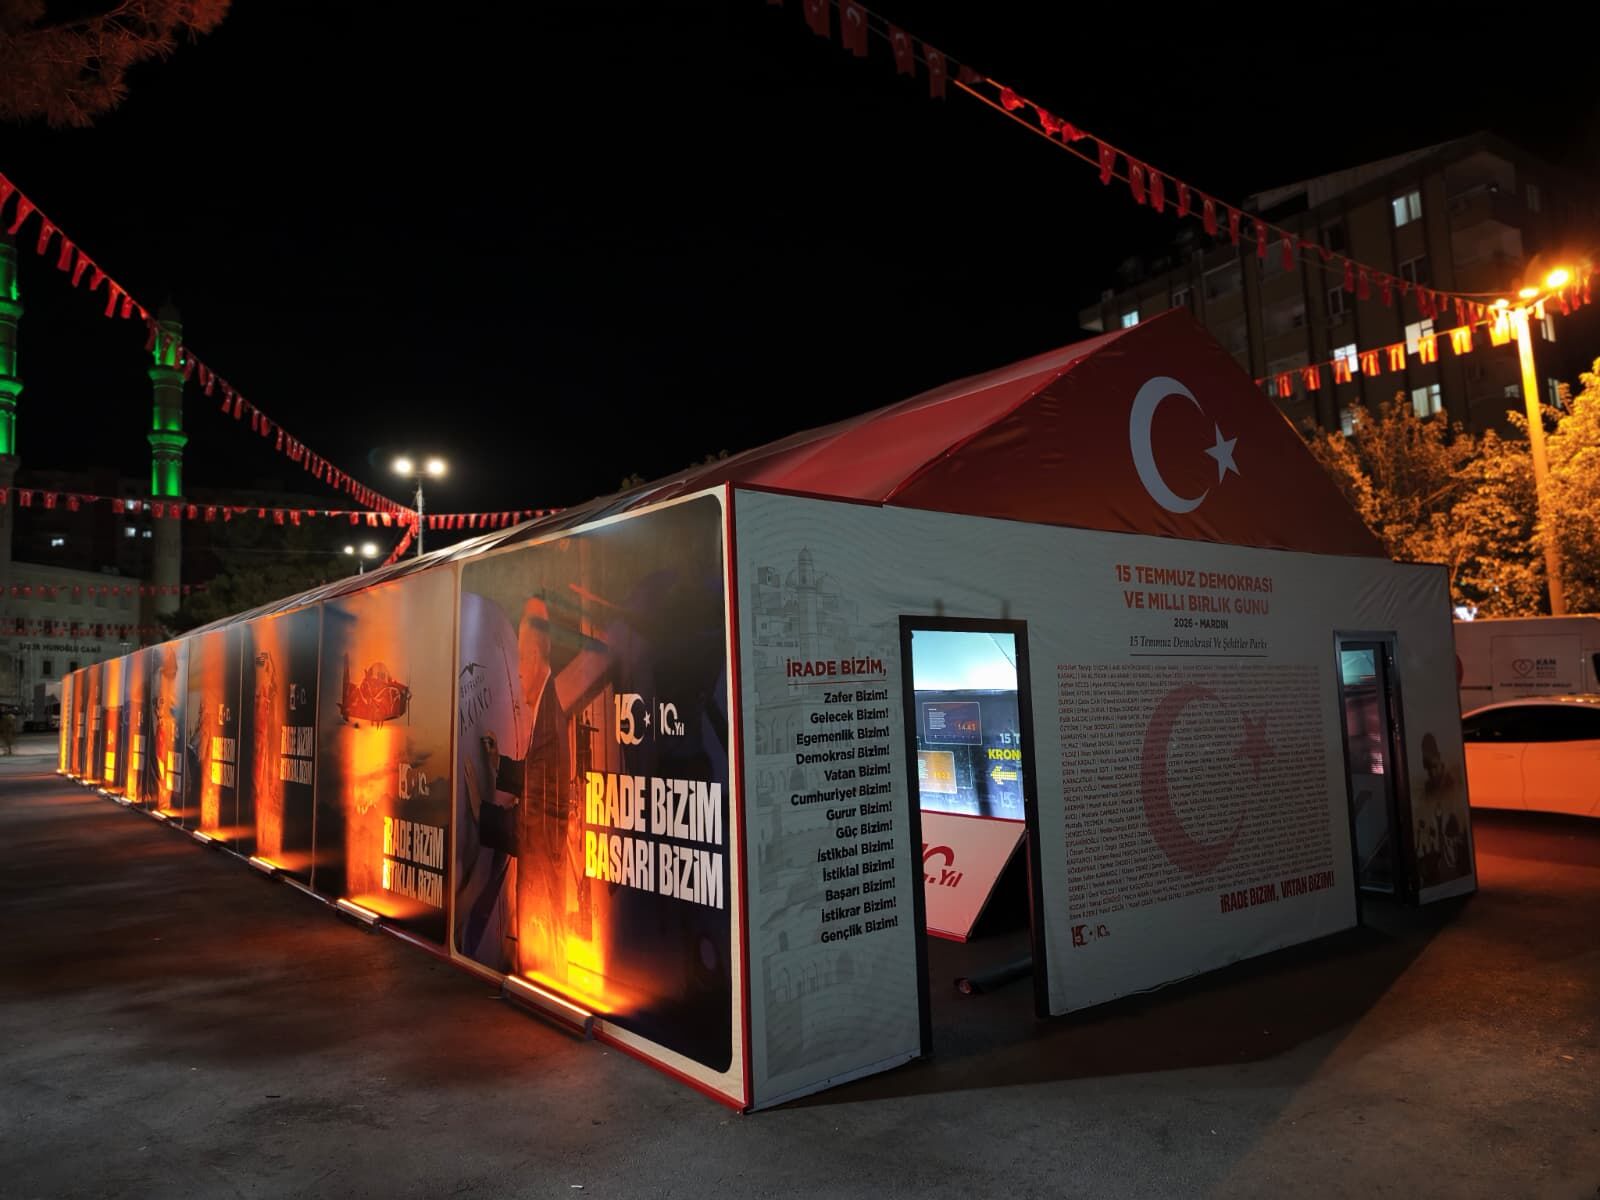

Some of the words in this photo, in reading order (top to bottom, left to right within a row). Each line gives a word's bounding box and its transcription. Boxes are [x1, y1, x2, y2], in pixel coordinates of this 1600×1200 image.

[1115, 564, 1132, 583] 15
[1135, 565, 1196, 588] TEMMUZ
[1199, 571, 1273, 593] DEMOKRASİ
[1124, 591, 1145, 609] VE
[1174, 617, 1193, 628] 2026
[1130, 635, 1138, 647] 15
[1140, 635, 1171, 648] Temmuz
[1173, 637, 1212, 649] Demokrasi
[787, 658, 837, 677] İRADE
[841, 656, 887, 677] BİZİM,
[824, 692, 853, 704] Zafer
[856, 689, 888, 702] Bizim!
[810, 710, 853, 724] Gelecek
[857, 708, 889, 720] Bizim!
[796, 729, 854, 746] Egemenlik
[857, 726, 890, 739] Bizim!
[1000, 733, 1011, 745] 15
[796, 747, 855, 765] Demokrasi
[858, 745, 890, 758] Bizim!
[988, 748, 1022, 762] KRON
[824, 769, 856, 781] Vatan
[859, 763, 891, 776] Bizim!
[791, 787, 857, 806] Cumhuriyet
[859, 782, 892, 796] Bizim!
[585, 771, 646, 833] İRADE
[651, 777, 722, 845] BİZİM
[826, 807, 857, 821] Gurur
[860, 801, 893, 816] Bizim!
[836, 826, 858, 839] Güç
[861, 820, 893, 835] Bizim!
[413, 822, 444, 870] BİZİM
[817, 844, 858, 863] İstikbal
[861, 839, 894, 855] Bizim!
[659, 843, 724, 910] BİZİM
[823, 863, 859, 882] İstiklal
[862, 858, 895, 874] Bizim!
[418, 868, 443, 909] BİZİM
[825, 887, 860, 902] Başarı
[863, 877, 896, 893] Bizim!
[1220, 889, 1249, 913] İRADE
[1281, 876, 1308, 898] VATAN
[1309, 870, 1335, 892] BİZİM!
[821, 904, 861, 923] İstikrar
[864, 896, 897, 913] Bizim!
[821, 924, 863, 943] Gençlik
[865, 915, 899, 933] Bizim!
